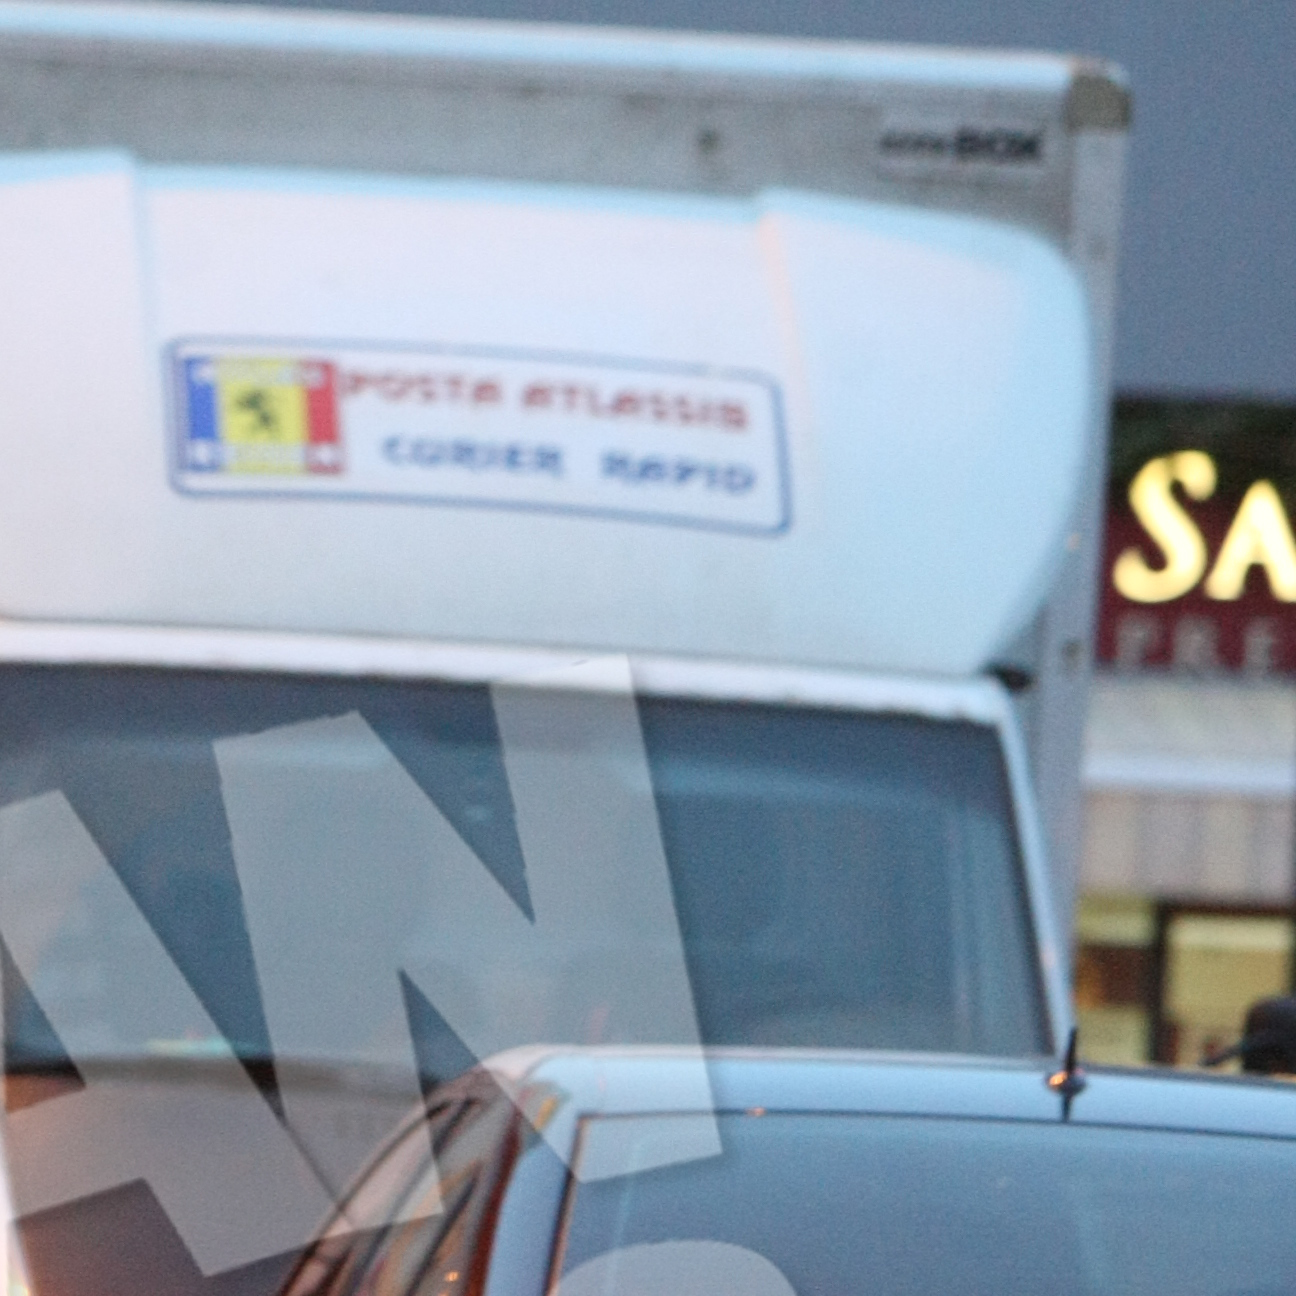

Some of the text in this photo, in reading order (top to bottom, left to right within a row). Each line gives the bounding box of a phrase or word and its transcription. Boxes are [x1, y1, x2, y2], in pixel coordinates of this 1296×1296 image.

[341, 369, 503, 410] POSTA
[382, 435, 756, 494] CURIER RAPID
[1113, 449, 1296, 603] SA
